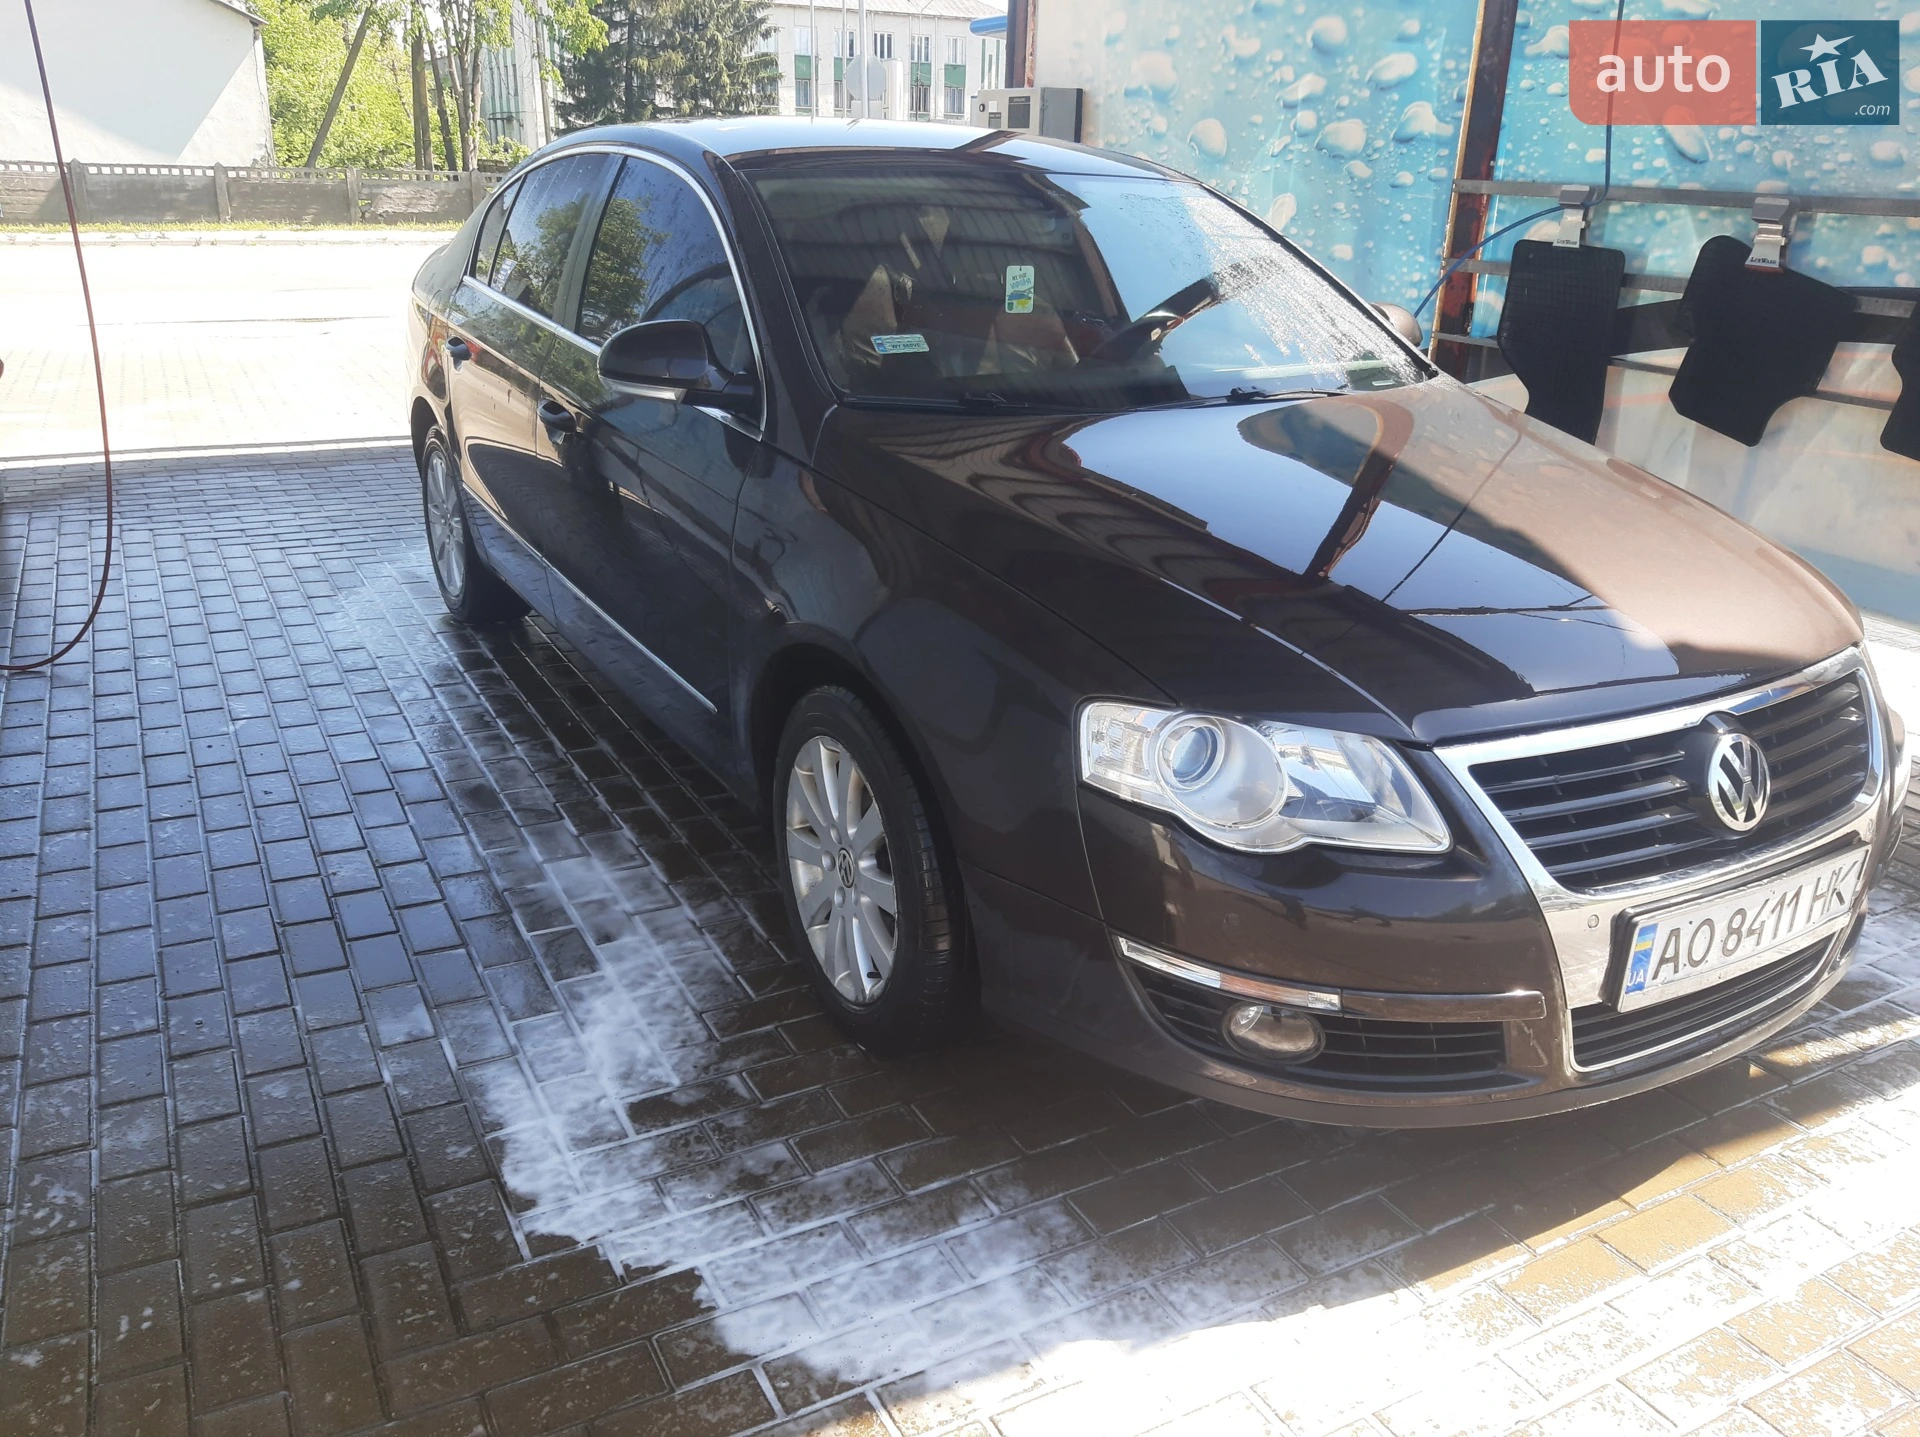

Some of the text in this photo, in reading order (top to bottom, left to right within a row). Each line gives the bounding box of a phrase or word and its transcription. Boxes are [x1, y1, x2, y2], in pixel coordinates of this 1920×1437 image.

[1652, 860, 1860, 980] AO 8411 HK
[1627, 969, 1645, 987] UA
